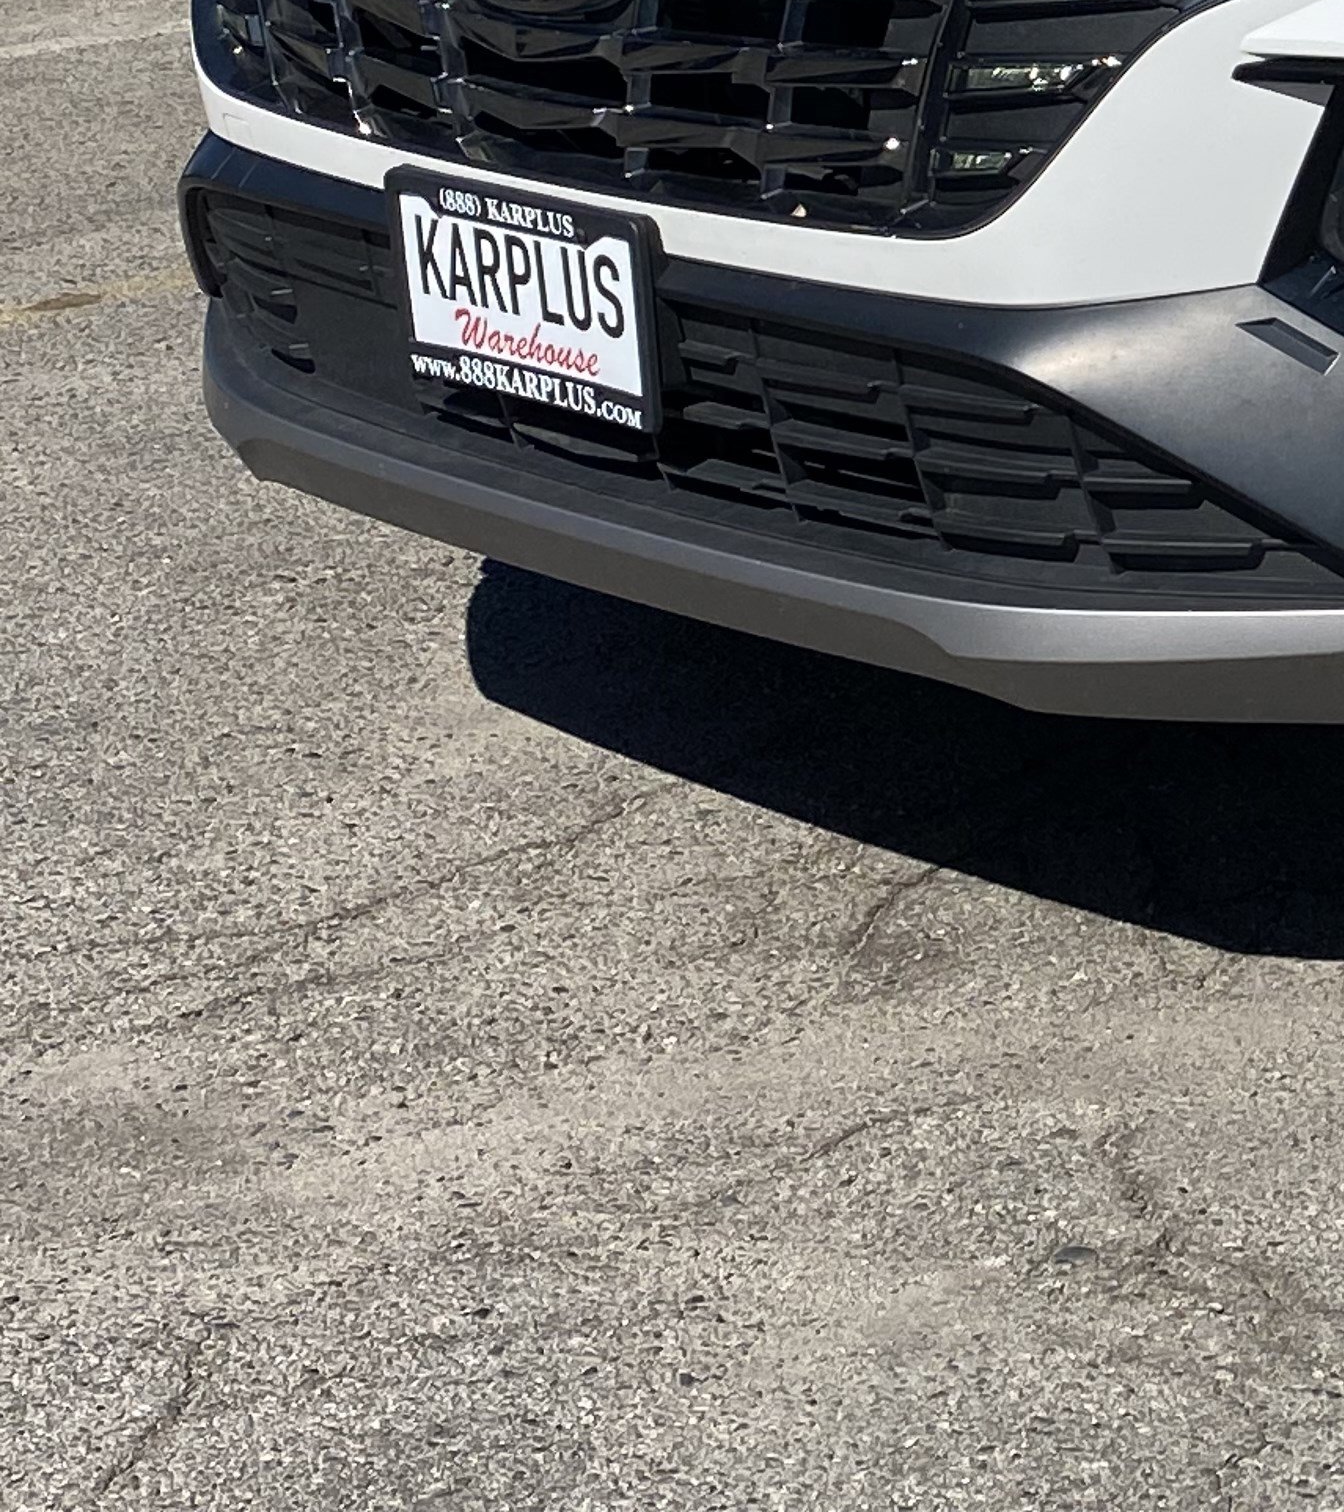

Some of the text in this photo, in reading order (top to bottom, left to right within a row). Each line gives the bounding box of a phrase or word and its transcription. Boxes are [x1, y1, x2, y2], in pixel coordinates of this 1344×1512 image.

[439, 187, 575, 238] (888) KARPLUS
[415, 213, 625, 339] KARPLUS
[455, 307, 602, 377] Warehouse
